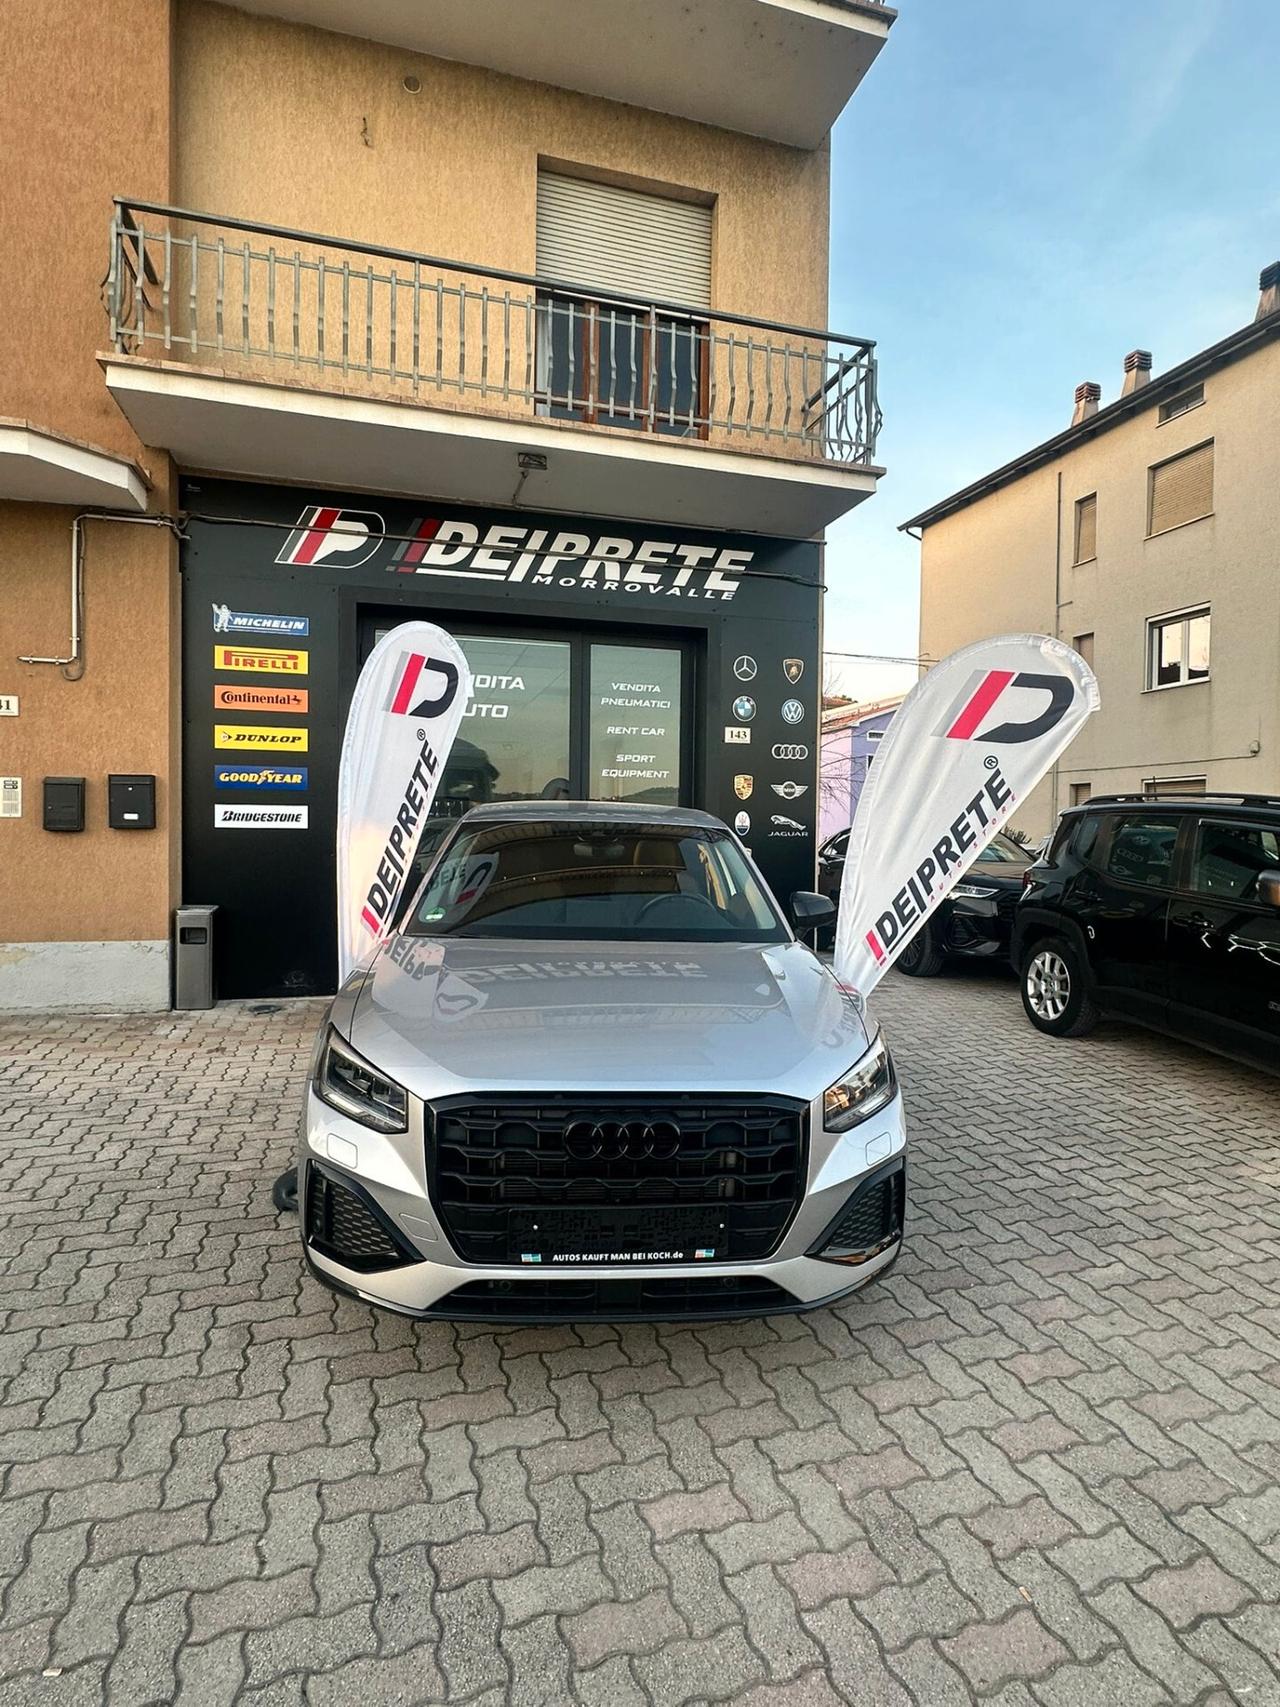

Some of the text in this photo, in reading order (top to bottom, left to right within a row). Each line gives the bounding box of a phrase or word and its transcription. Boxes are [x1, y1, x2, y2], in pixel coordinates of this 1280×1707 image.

[532, 575, 736, 600] MORROVALLE
[233, 617, 305, 630] MICHELIN
[224, 650, 298, 670] PIRELLI
[611, 682, 661, 693] VENDITA
[221, 690, 291, 705] Continental
[601, 697, 671, 709] PNEUMATICI
[607, 726, 665, 736] RENT CAR
[729, 730, 748, 740] 143
[234, 734, 302, 744] DUNLOP
[616, 754, 656, 763] SPORT
[602, 768, 670, 778] EQUIPMENT
[221, 810, 303, 823] BRIDGESTONE
[552, 1251, 684, 1262] AUTOS KAUFT MAN BEI KOCH.de
